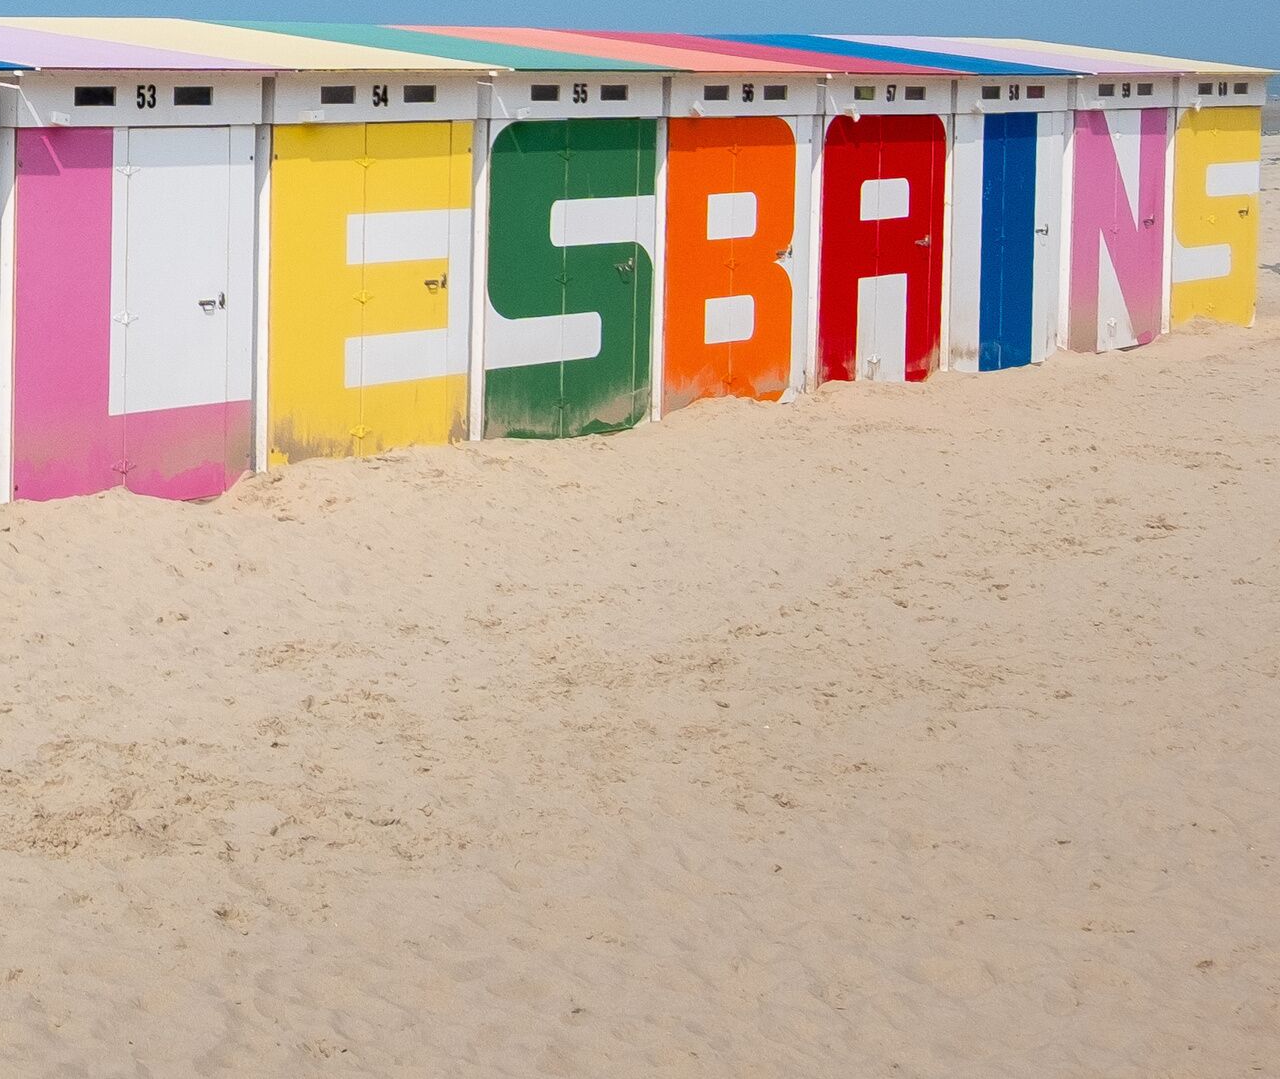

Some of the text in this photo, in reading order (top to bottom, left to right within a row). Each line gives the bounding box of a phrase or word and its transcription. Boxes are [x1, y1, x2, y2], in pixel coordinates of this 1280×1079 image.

[136, 83, 157, 110] 53
[372, 84, 389, 108] 54
[572, 83, 588, 104] 55
[742, 82, 755, 103] 56
[886, 84, 897, 102] 57
[1008, 84, 1020, 101] 58
